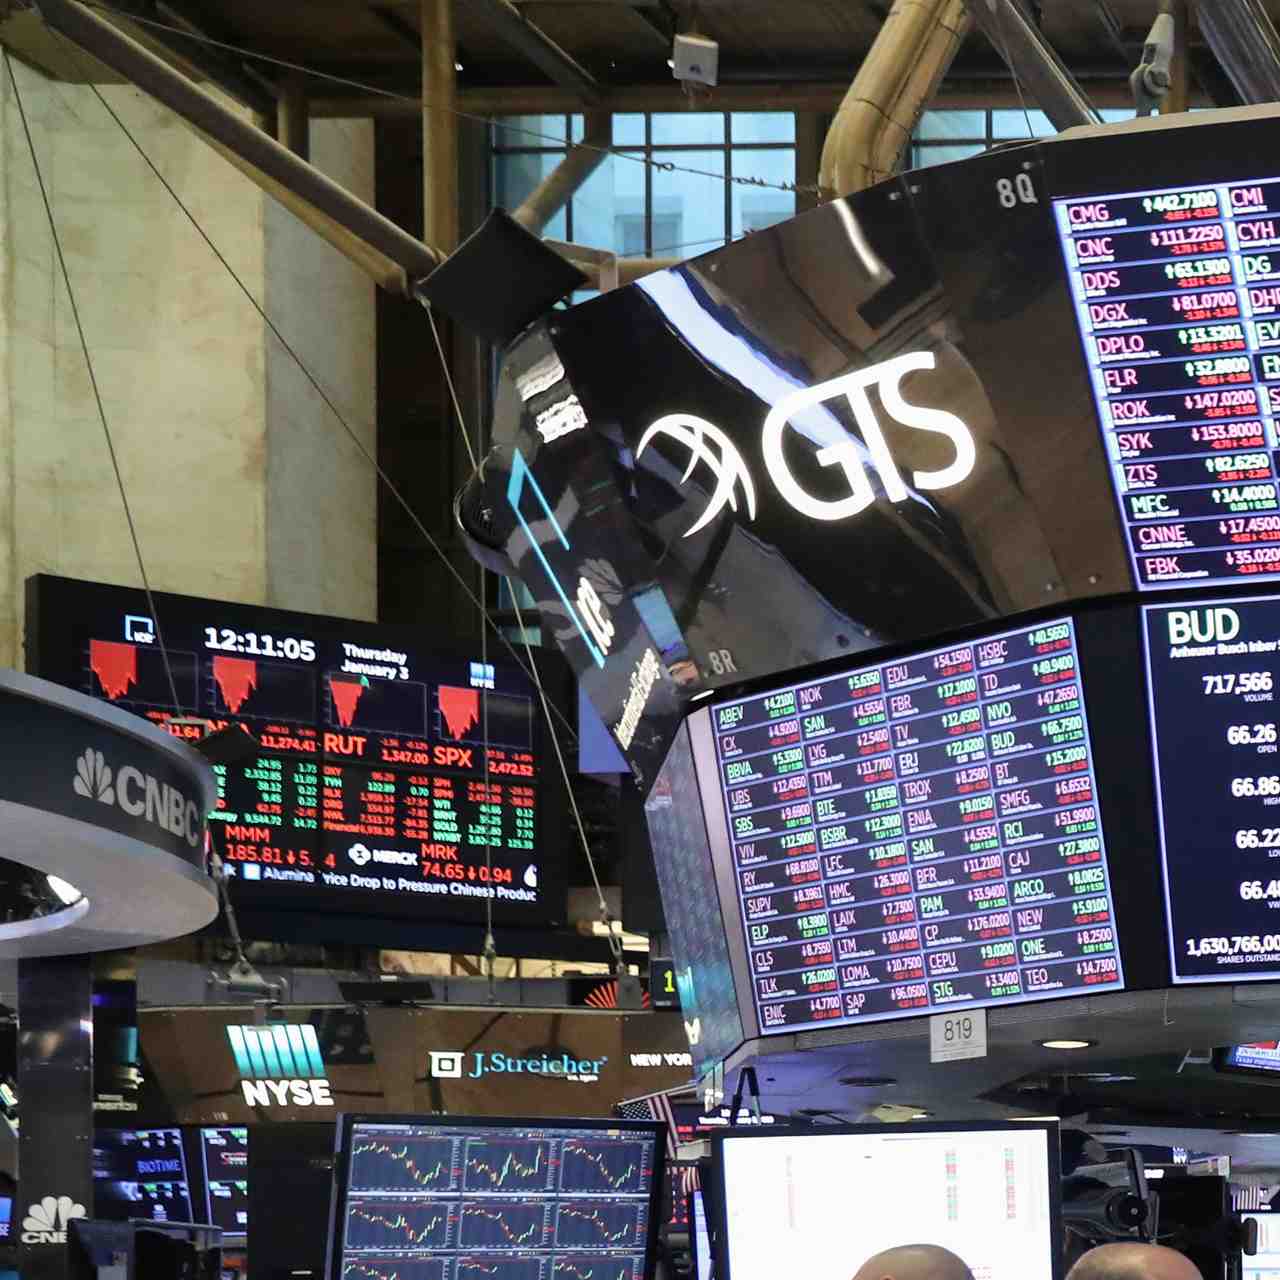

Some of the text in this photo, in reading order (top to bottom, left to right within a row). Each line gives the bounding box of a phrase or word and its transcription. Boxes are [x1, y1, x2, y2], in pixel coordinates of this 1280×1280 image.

[996, 173, 1038, 208] 8Q
[1076, 238, 1114, 257] CNC
[762, 351, 976, 521] GTS
[1138, 516, 1280, 545] CNNE 17.4500
[1168, 607, 1239, 645] BUD
[204, 627, 316, 661] 12:11:05
[342, 642, 407, 665] Thursday
[978, 640, 1008, 661] HSBC
[341, 659, 409, 680] January 3
[1203, 672, 1272, 694] 717,566
[324, 732, 366, 755] RUT
[991, 731, 1015, 750] BUD
[1227, 724, 1277, 746] 66.26
[434, 747, 472, 768] SPX
[1231, 776, 1280, 798] 66.86
[116, 766, 199, 847] CNBC
[225, 825, 270, 842] MMM
[225, 844, 282, 864] 185.81
[421, 844, 458, 861] MRK
[421, 862, 512, 883] 74.65 0.94
[350, 874, 379, 890] Drop
[383, 878, 396, 889] to
[398, 879, 448, 894] Pressure
[450, 882, 495, 898] Chinese
[1016, 910, 1043, 929] NEW
[1027, 969, 1048, 987] TEO
[944, 1017, 972, 1041] 819
[469, 1052, 604, 1078] J.Streicher
[241, 1079, 334, 1107] NYSE
